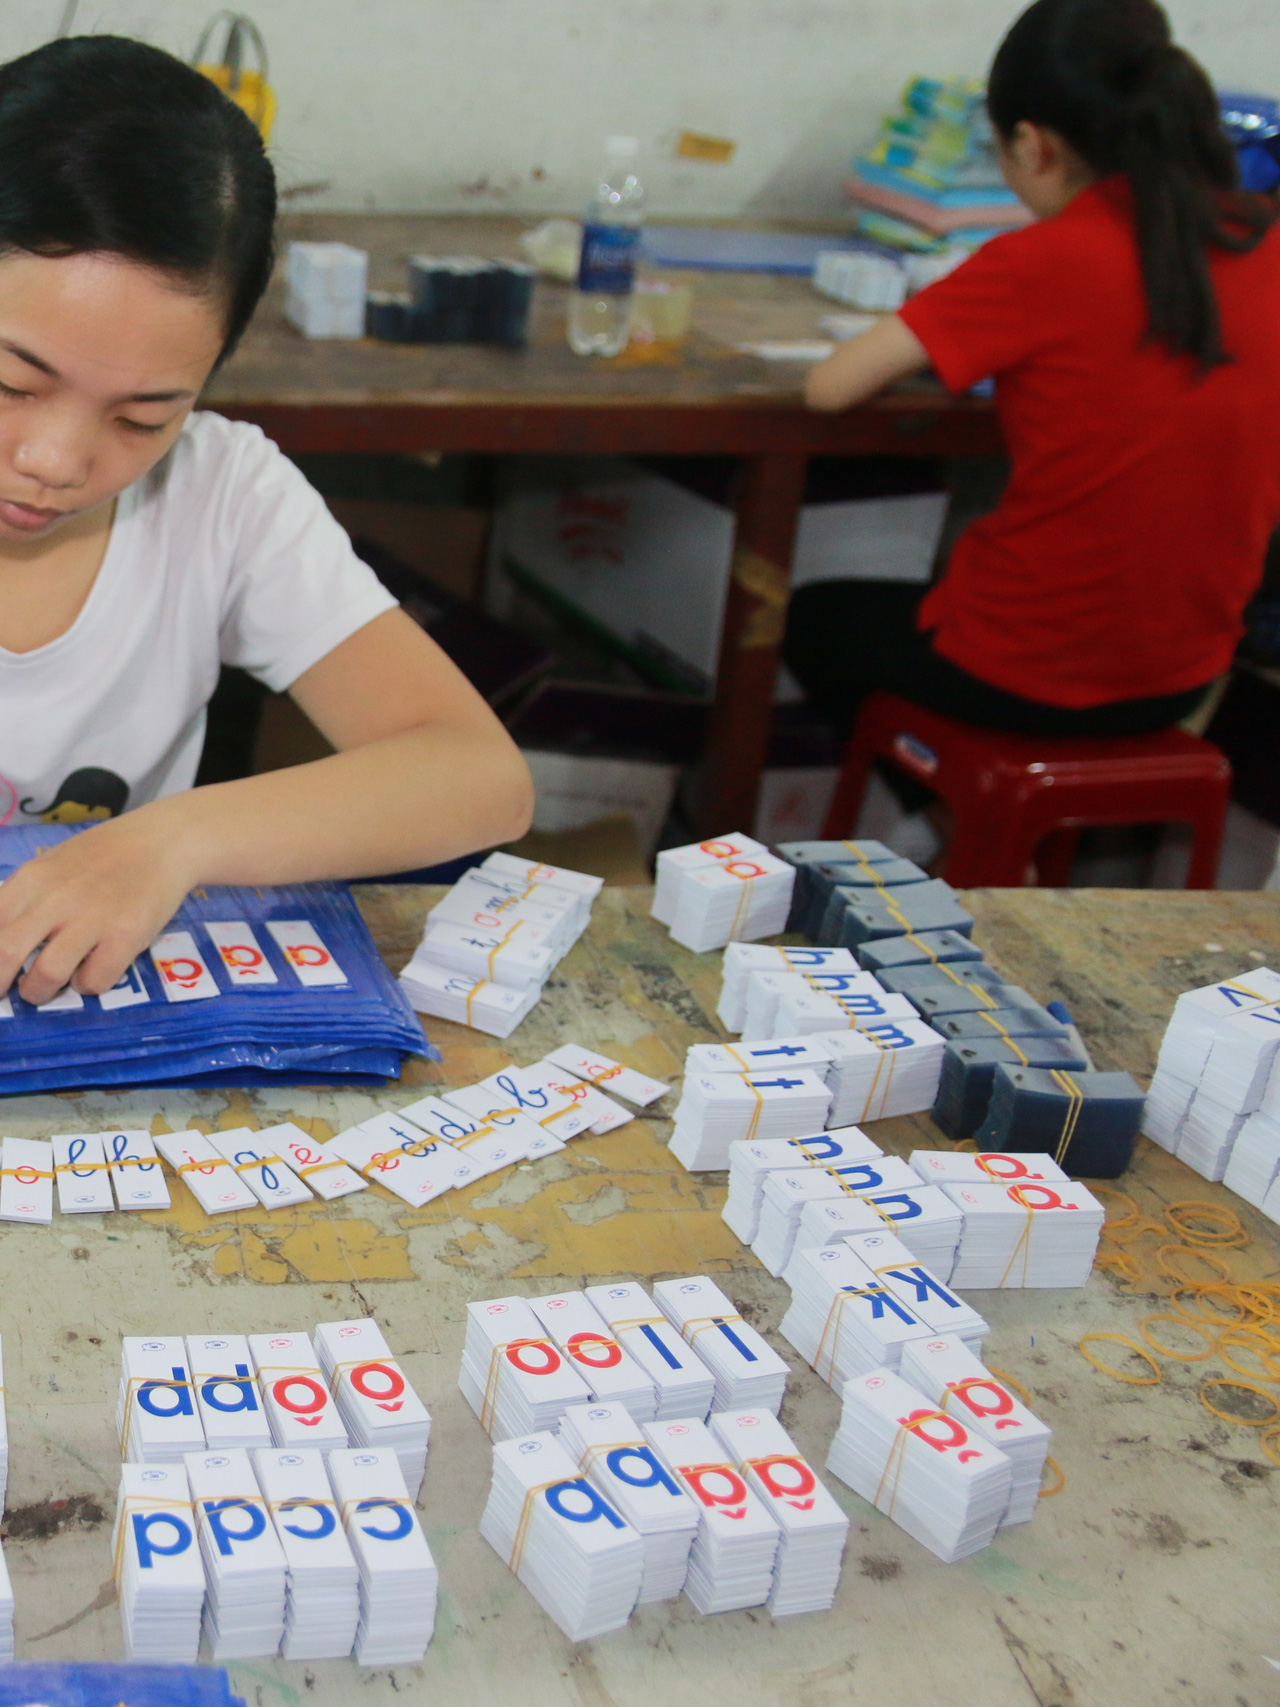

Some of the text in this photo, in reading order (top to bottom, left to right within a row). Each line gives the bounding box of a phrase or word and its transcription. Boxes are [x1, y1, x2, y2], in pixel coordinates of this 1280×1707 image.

[700, 841, 742, 858] a
[724, 861, 769, 879] a
[285, 944, 329, 967] a
[461, 937, 500, 948] t
[786, 951, 832, 964] h
[802, 975, 854, 990] h
[832, 995, 885, 1015] m
[752, 1046, 805, 1056] t
[858, 1025, 914, 1048] m
[496, 1075, 548, 1108] b
[745, 1079, 803, 1088] t
[487, 1108, 516, 1126] c
[68, 1138, 97, 1178] l
[112, 1135, 156, 1172] h
[182, 1150, 216, 1175] i
[289, 1143, 323, 1165] ê
[789, 1136, 842, 1158] n
[14, 1165, 40, 1185] o
[234, 1150, 280, 1190] g
[827, 1165, 882, 1189] n
[975, 1154, 1044, 1179] ơ
[861, 1194, 922, 1220] n
[1008, 1184, 1078, 1210] ơ
[842, 1282, 918, 1325] k
[886, 1268, 961, 1308] k
[506, 1339, 560, 1375] o
[568, 1333, 622, 1368] o
[640, 1325, 682, 1369] l
[713, 1320, 757, 1361] l
[138, 1367, 193, 1417] p
[202, 1365, 258, 1412] p
[273, 1376, 327, 1426] ô
[351, 1364, 405, 1412] ô
[947, 1378, 1021, 1429] ă
[899, 1409, 982, 1463] ă
[607, 1447, 682, 1496] b
[749, 1455, 815, 1510] â
[546, 1480, 626, 1529] b
[679, 1464, 746, 1519] â
[204, 1500, 266, 1555] d
[280, 1496, 335, 1539] c
[357, 1496, 413, 1540] c
[133, 1514, 191, 1568] d
